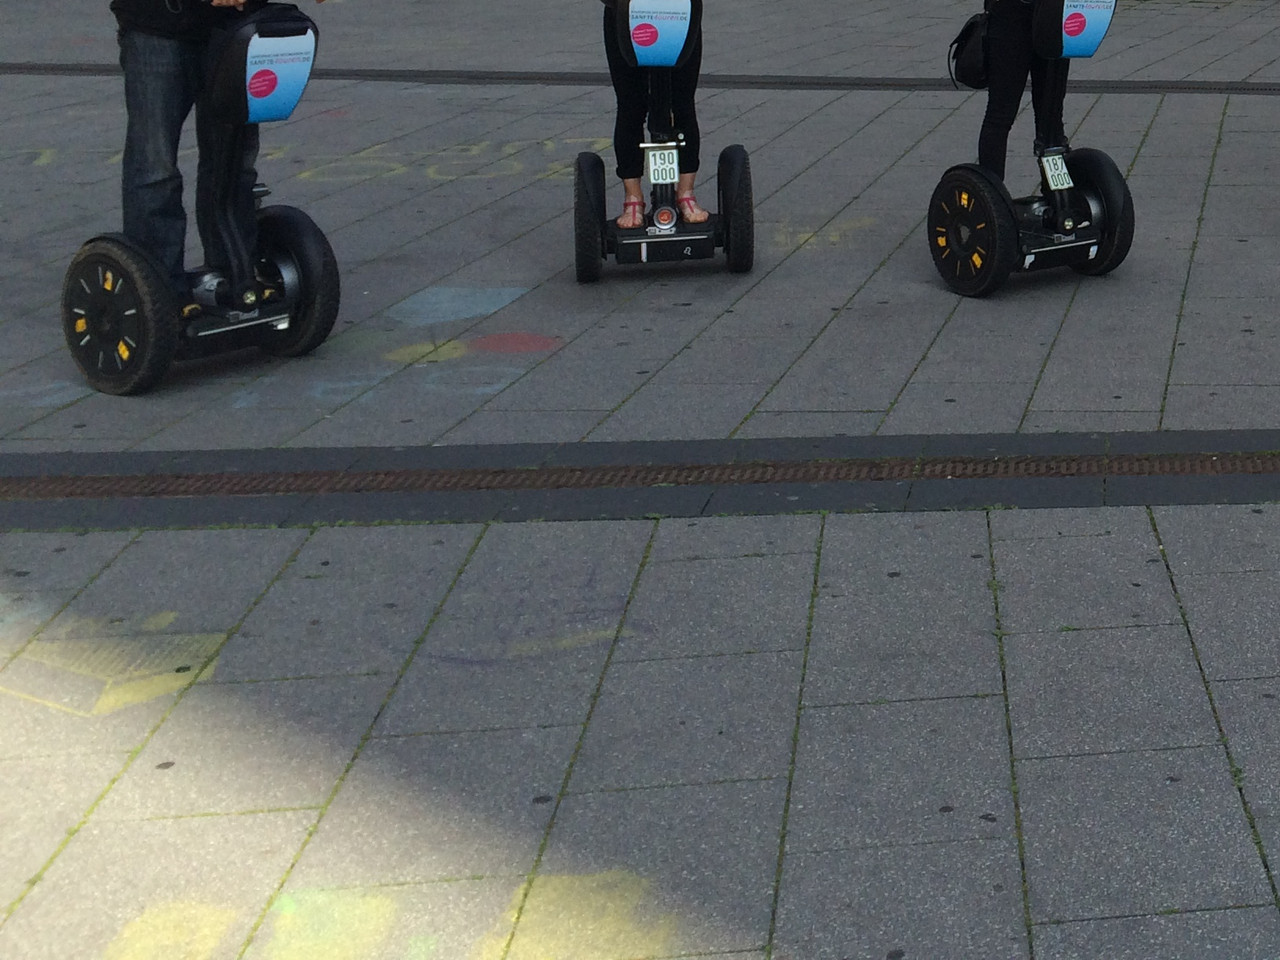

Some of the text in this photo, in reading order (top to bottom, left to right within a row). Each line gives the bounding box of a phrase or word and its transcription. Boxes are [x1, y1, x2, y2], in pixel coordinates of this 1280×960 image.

[651, 151, 675, 167] 190
[1046, 156, 1064, 172] 187
[653, 167, 675, 181] 000
[1050, 172, 1071, 187] 000
